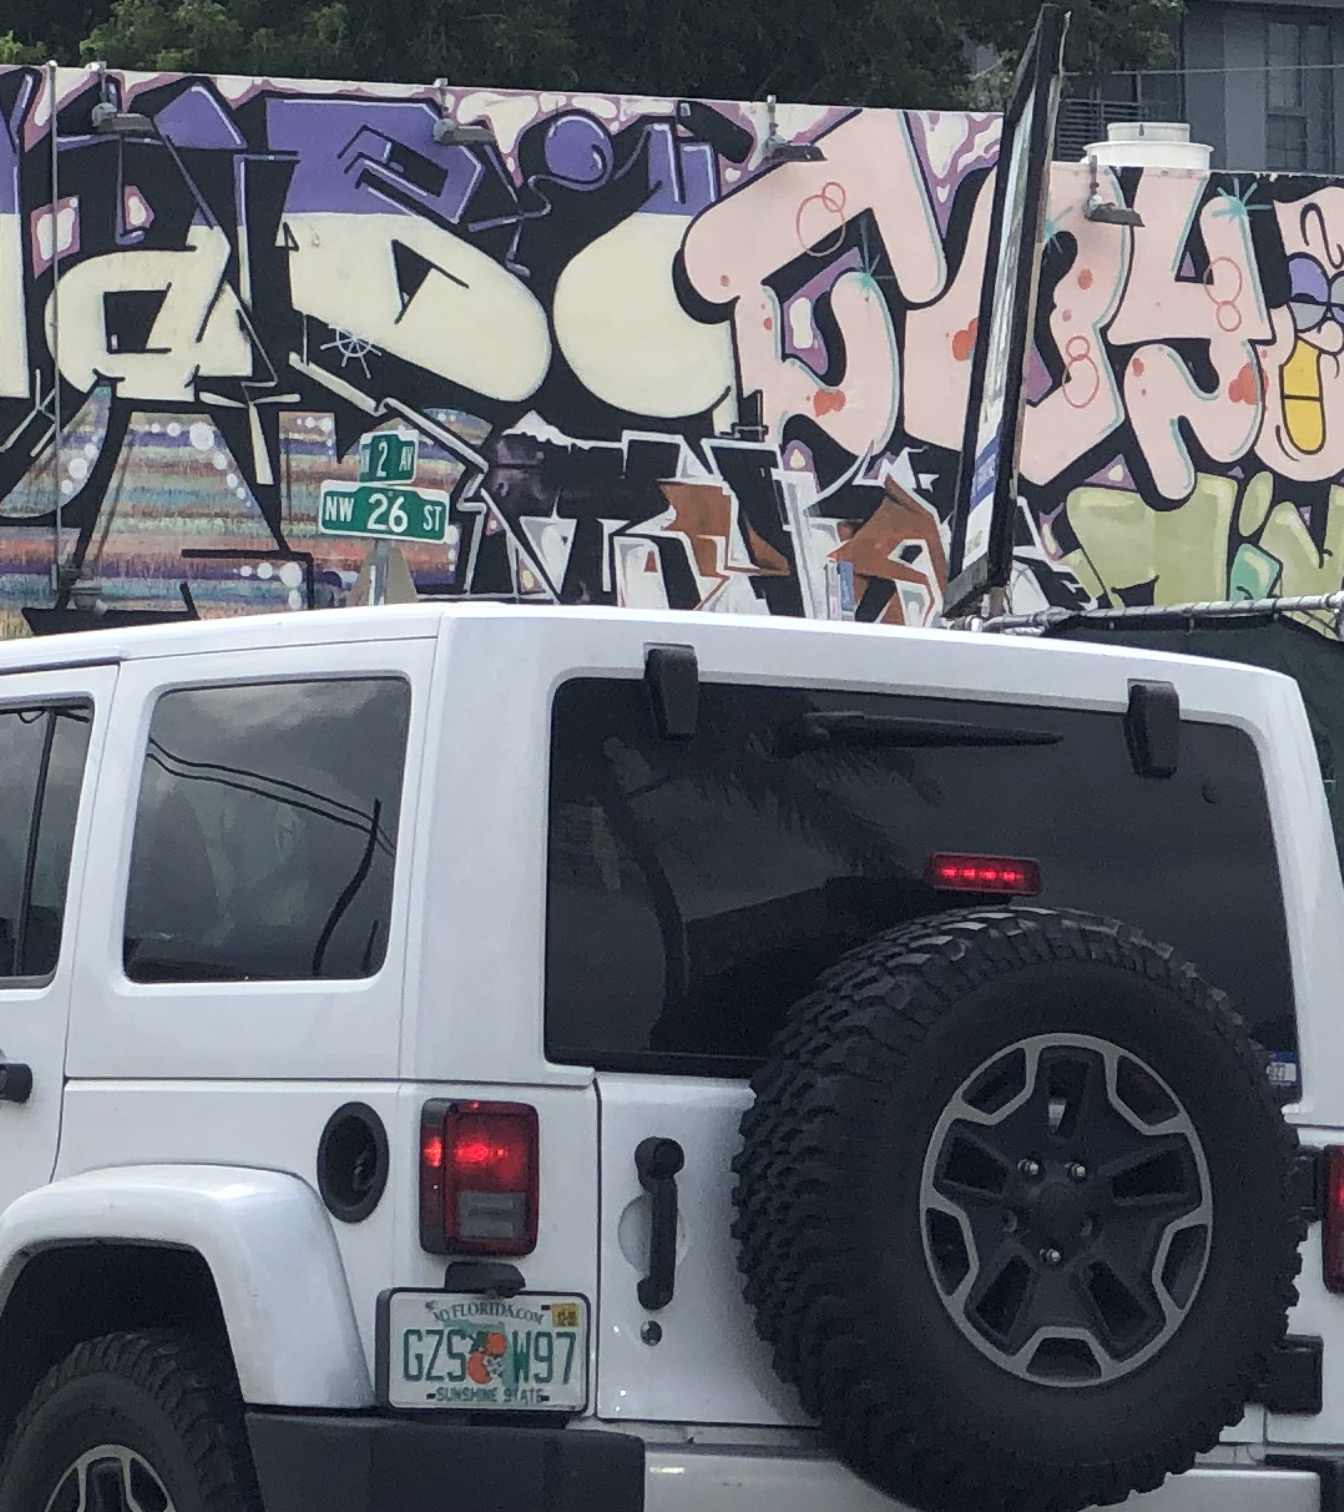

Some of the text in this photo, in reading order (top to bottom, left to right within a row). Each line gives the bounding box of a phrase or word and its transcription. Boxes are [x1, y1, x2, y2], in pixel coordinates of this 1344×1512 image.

[376, 440, 388, 477] 2
[399, 446, 414, 472] AV
[324, 493, 443, 533] NW 26 ST
[403, 1328, 577, 1385] GZS W97
[436, 1386, 497, 1402] SUNSHINE
